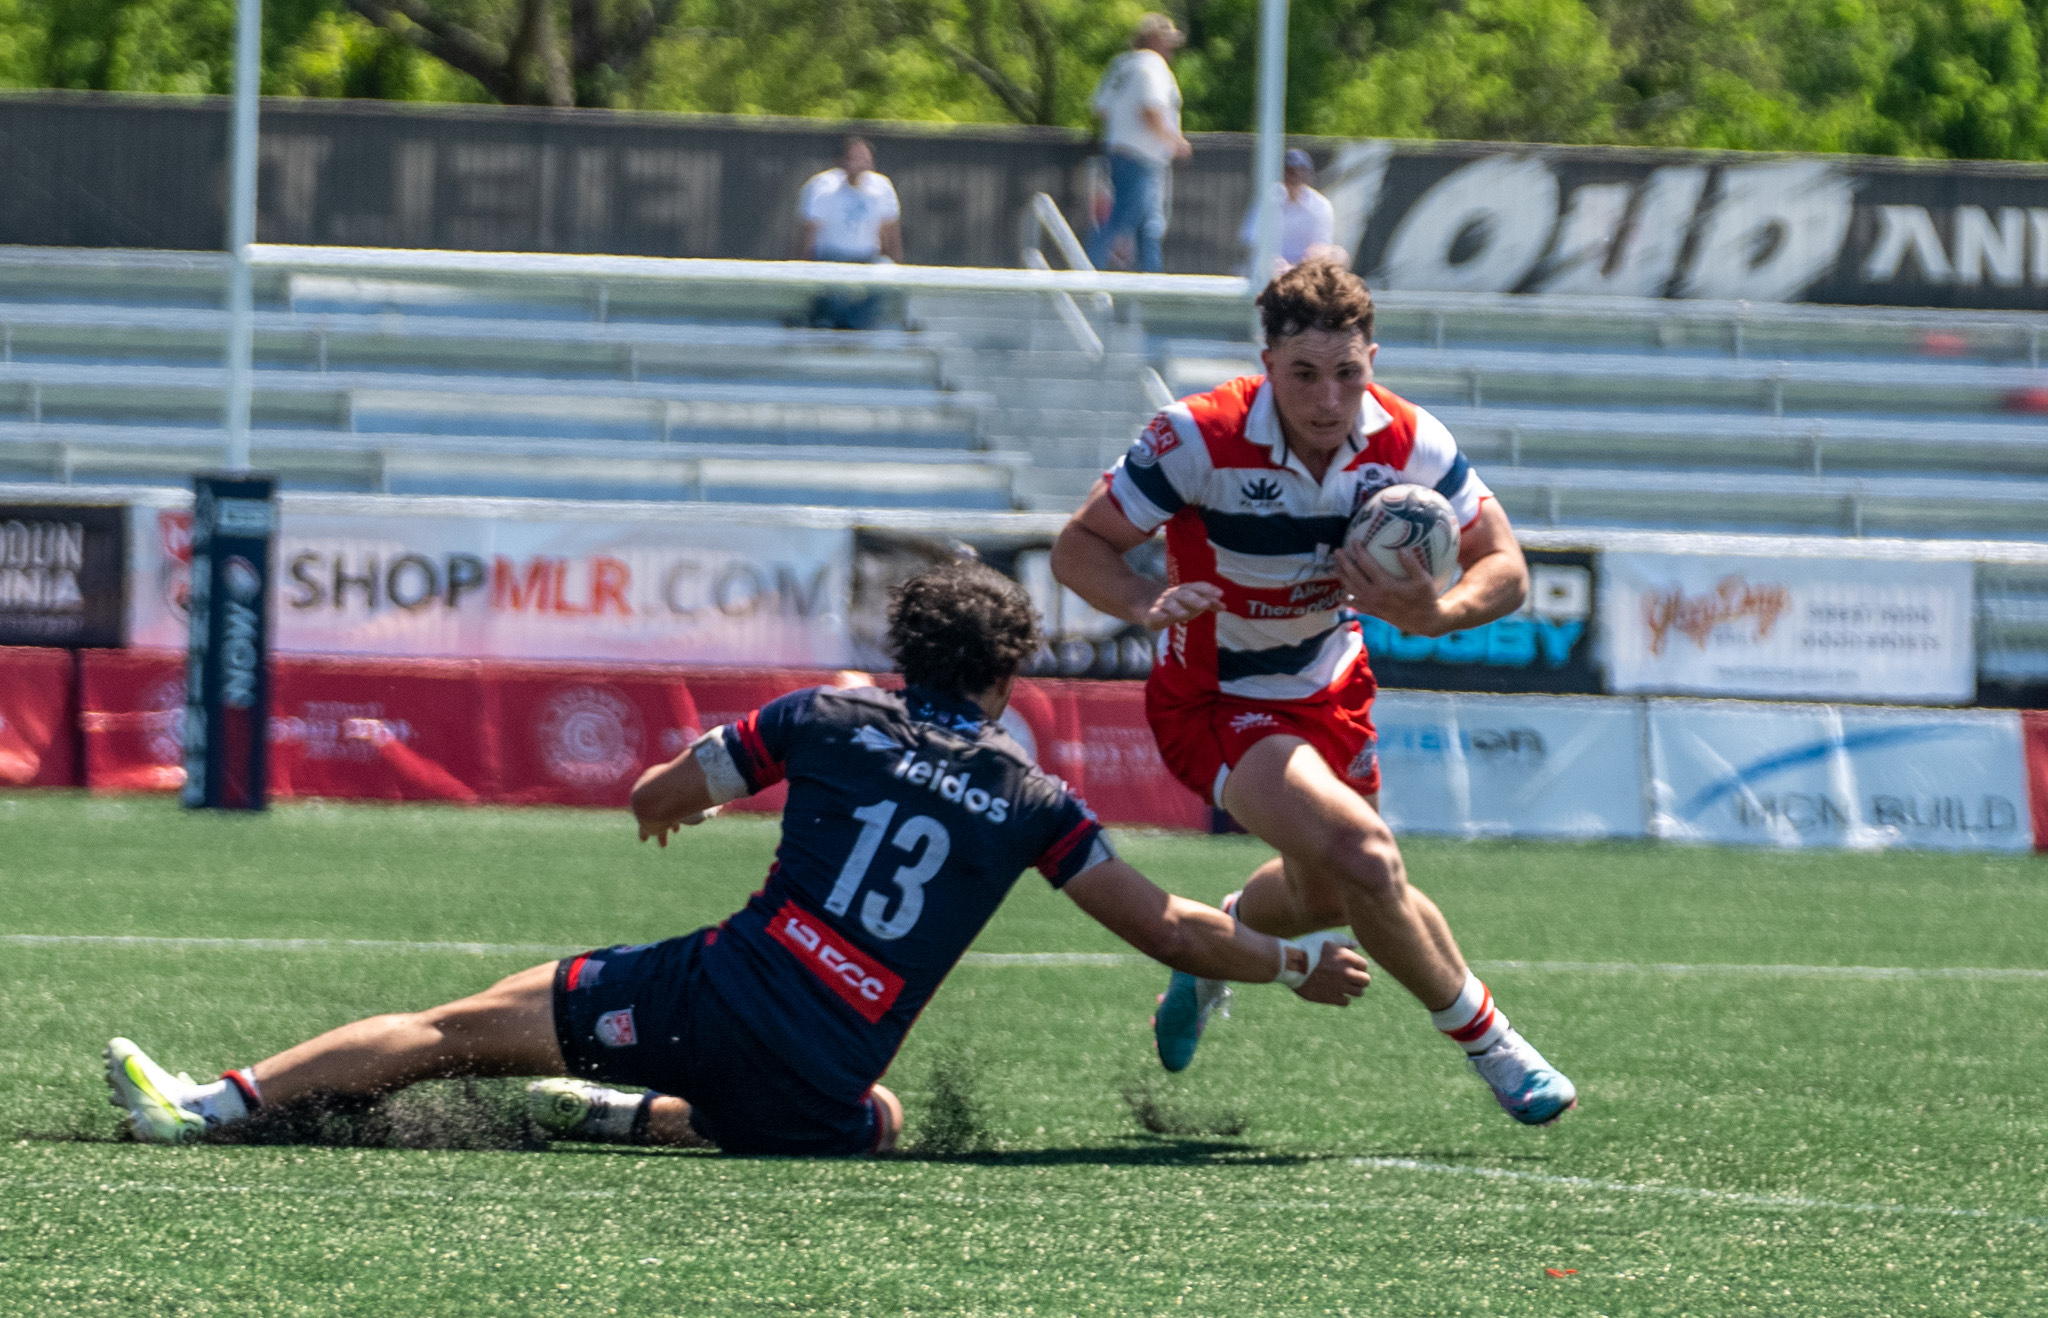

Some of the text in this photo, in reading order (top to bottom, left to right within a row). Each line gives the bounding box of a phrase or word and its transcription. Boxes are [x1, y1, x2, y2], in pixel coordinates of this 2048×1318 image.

[1864, 203, 2048, 288] AN
[895, 750, 1010, 824] leidos
[823, 799, 951, 941] 13
